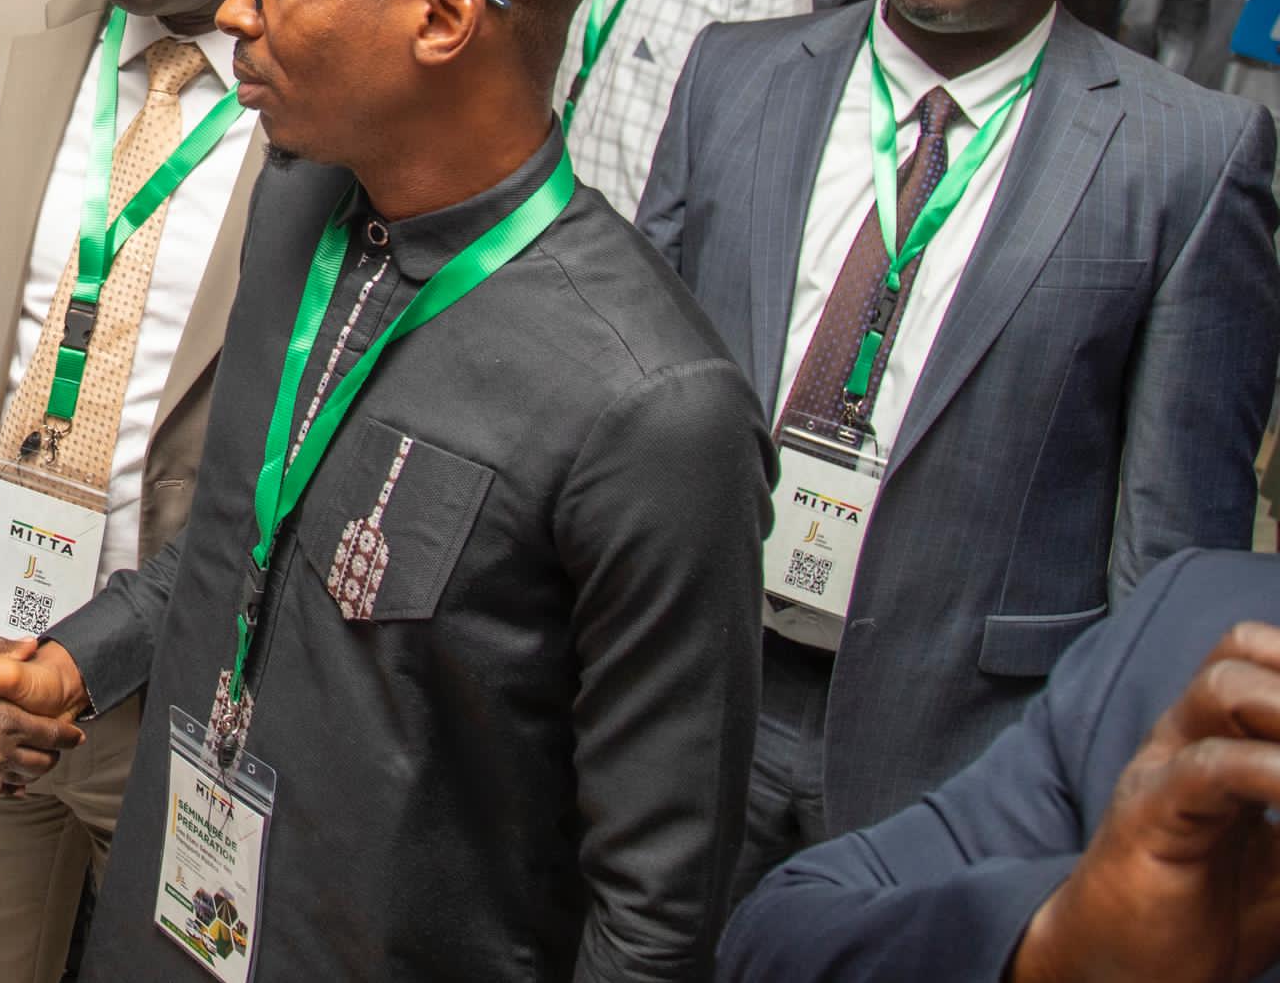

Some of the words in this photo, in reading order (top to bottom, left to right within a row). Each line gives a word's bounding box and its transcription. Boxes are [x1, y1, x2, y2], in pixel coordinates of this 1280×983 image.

[793, 492, 859, 523] MITTA
[10, 525, 74, 557] MITTA
[196, 783, 234, 820] MITTA
[177, 813, 236, 865] PRÉPARATION
[178, 799, 223, 842] SÉMINAIRE
[225, 836, 238, 851] DE
